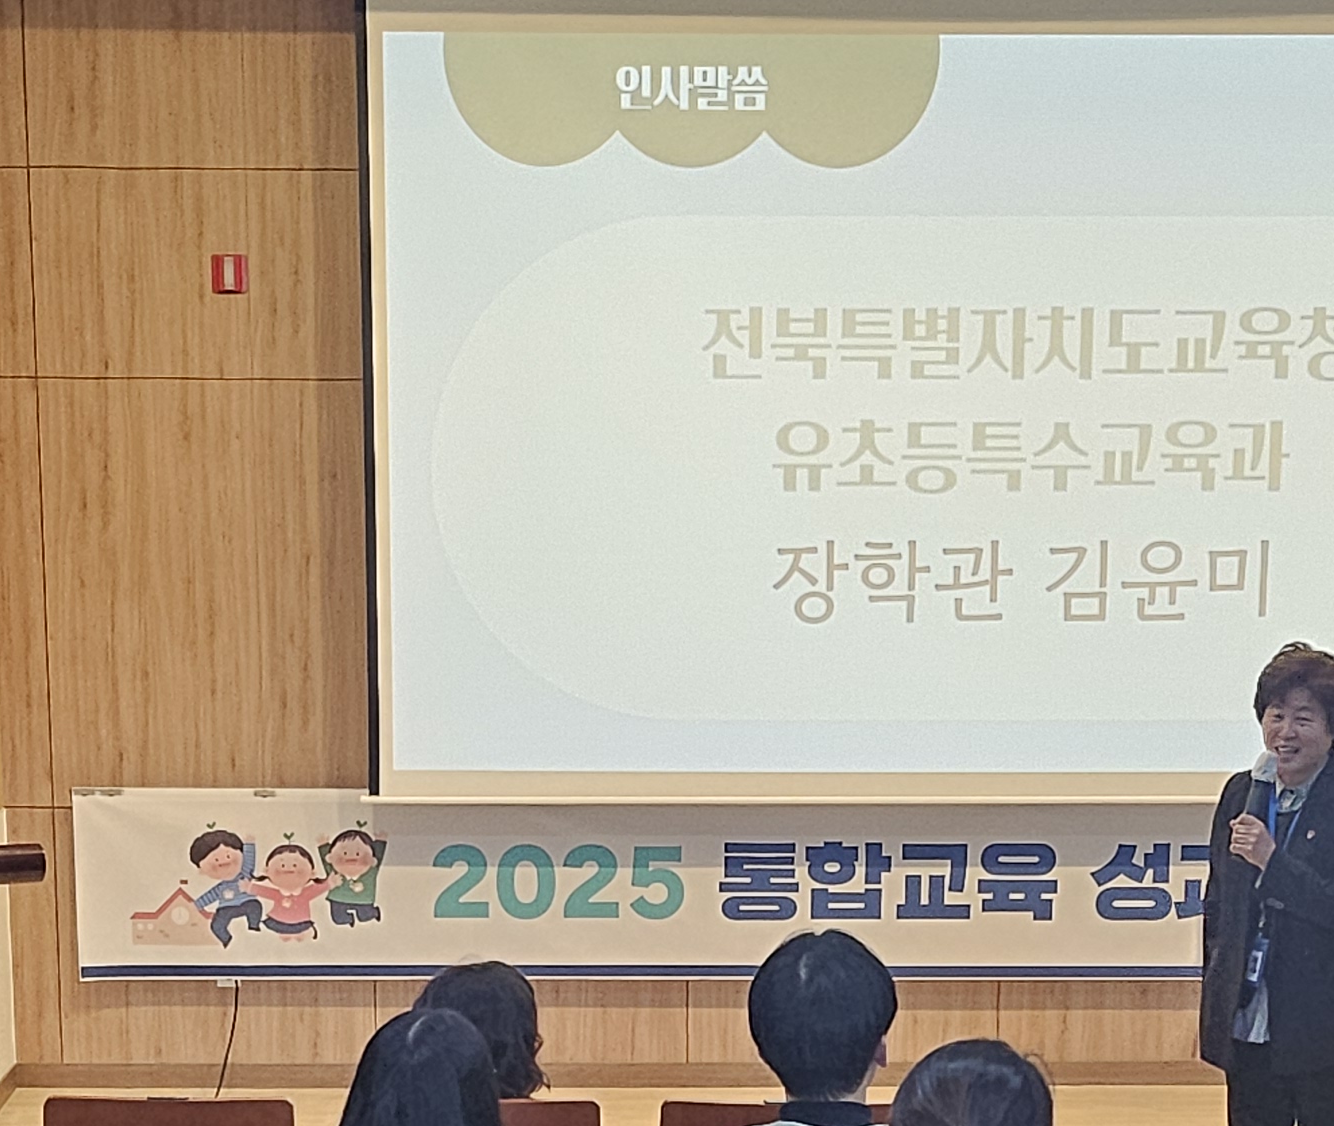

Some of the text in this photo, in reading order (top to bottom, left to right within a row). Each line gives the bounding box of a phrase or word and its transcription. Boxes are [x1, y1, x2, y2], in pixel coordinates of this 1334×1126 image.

[615, 64, 770, 111] 인사말씀
[772, 419, 1291, 495] 유초등특수교육과
[772, 539, 1273, 625] 장학관 김윤미
[433, 844, 685, 920] 2025
[719, 841, 1058, 920] 통합교육
